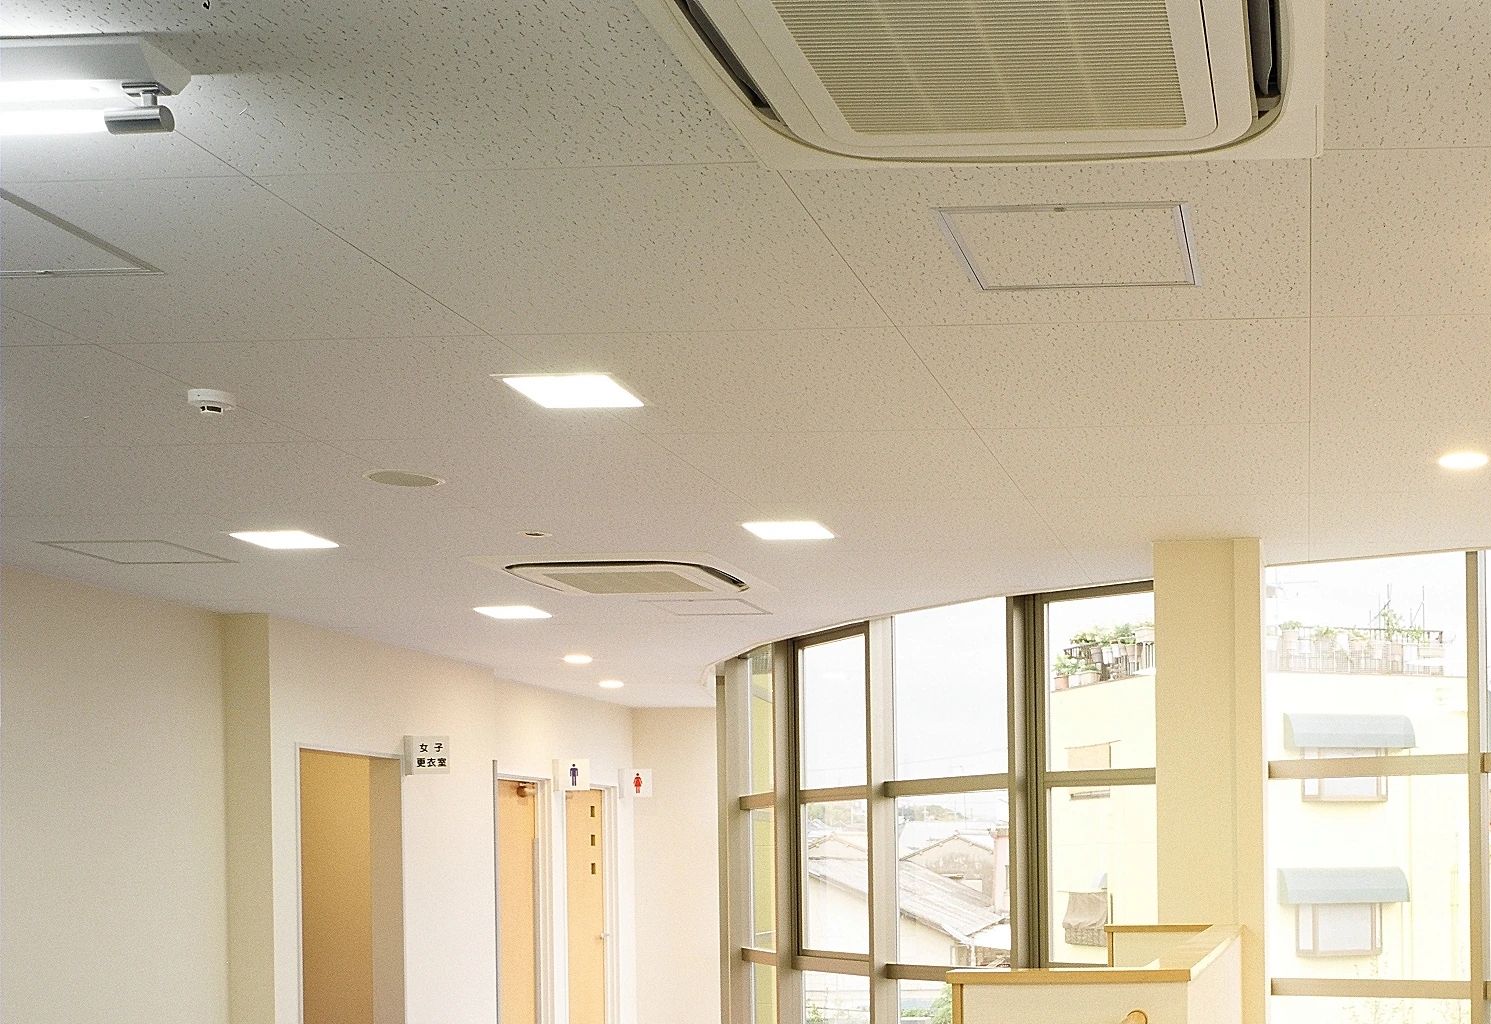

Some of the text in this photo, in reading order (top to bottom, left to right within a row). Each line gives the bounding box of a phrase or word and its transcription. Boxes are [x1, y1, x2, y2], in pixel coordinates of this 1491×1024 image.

[419, 742, 443, 753] 女子
[416, 757, 447, 768] 更衣室
